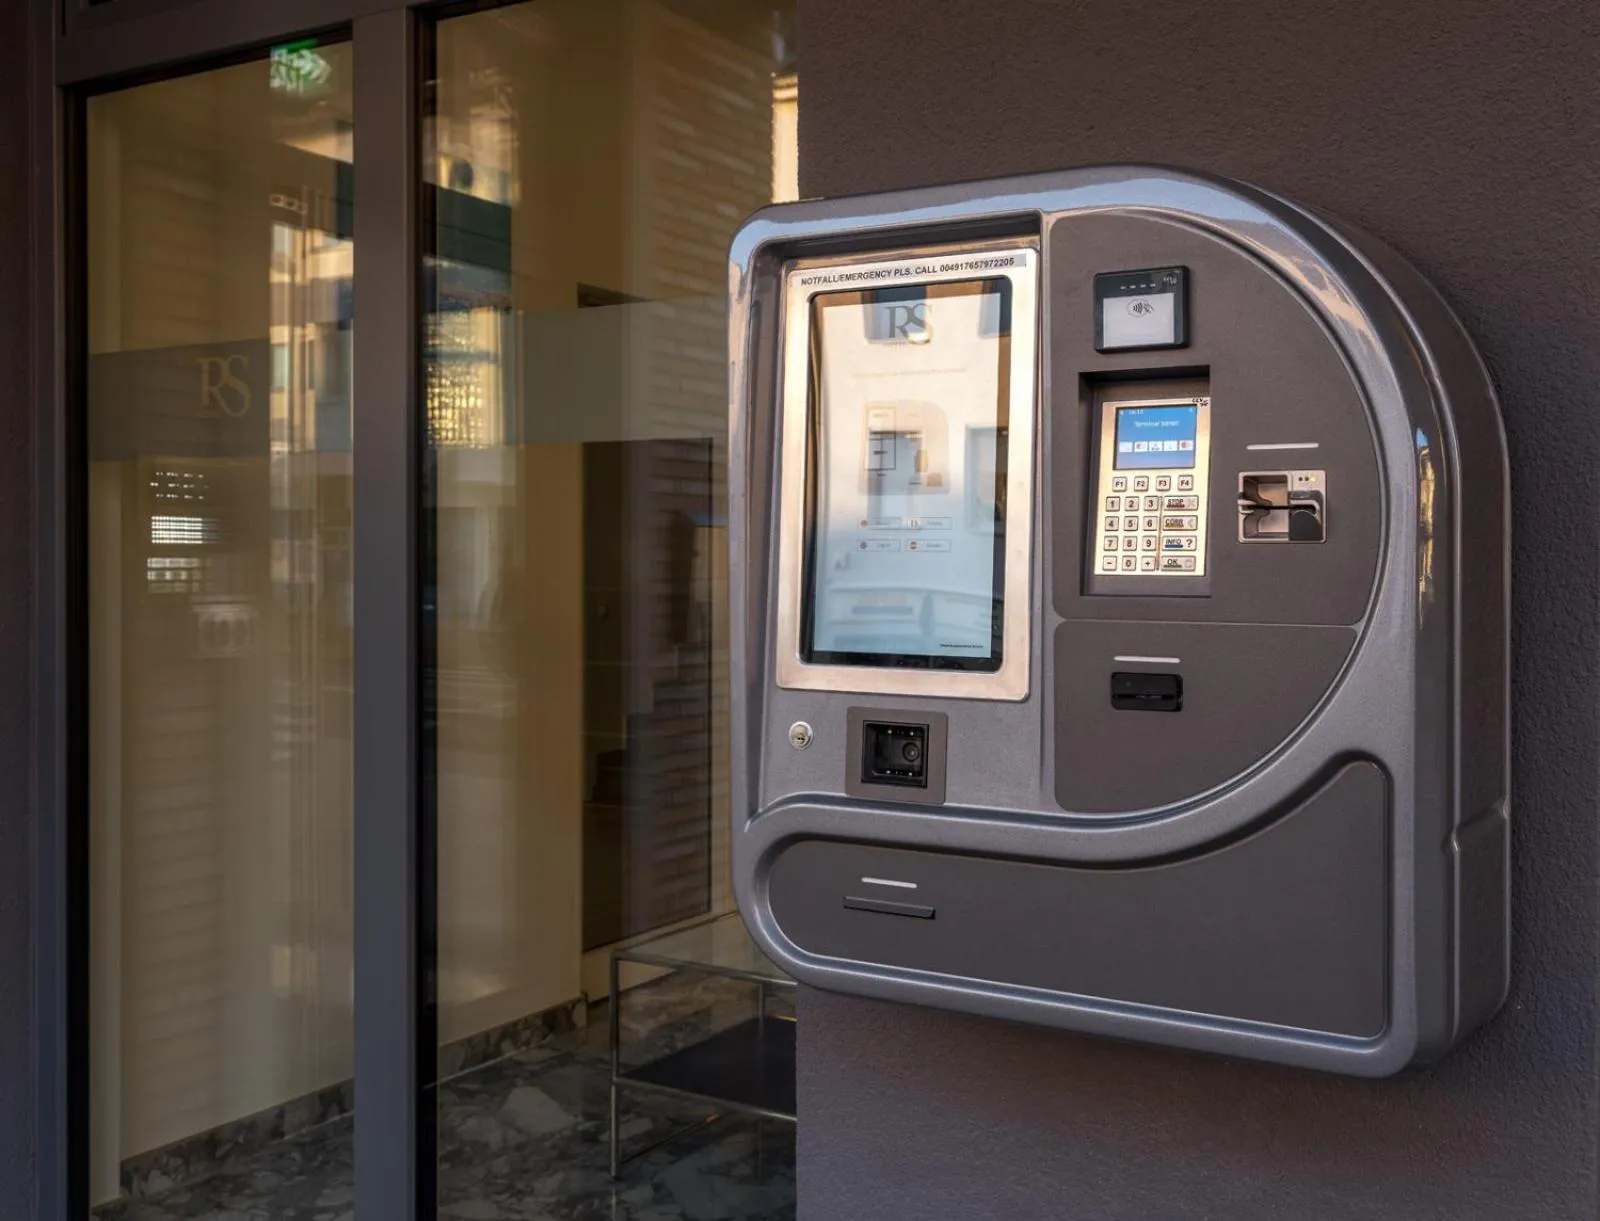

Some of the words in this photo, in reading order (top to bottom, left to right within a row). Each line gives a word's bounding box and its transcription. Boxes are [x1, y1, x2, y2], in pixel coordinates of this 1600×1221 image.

[801, 269, 891, 286] NOTFALL/EMERGENCY
[893, 268, 913, 277] PLS.
[915, 265, 938, 275] CALL
[940, 257, 1015, 272] 004917657972205
[885, 302, 935, 346] RS
[196, 354, 252, 418] RS
